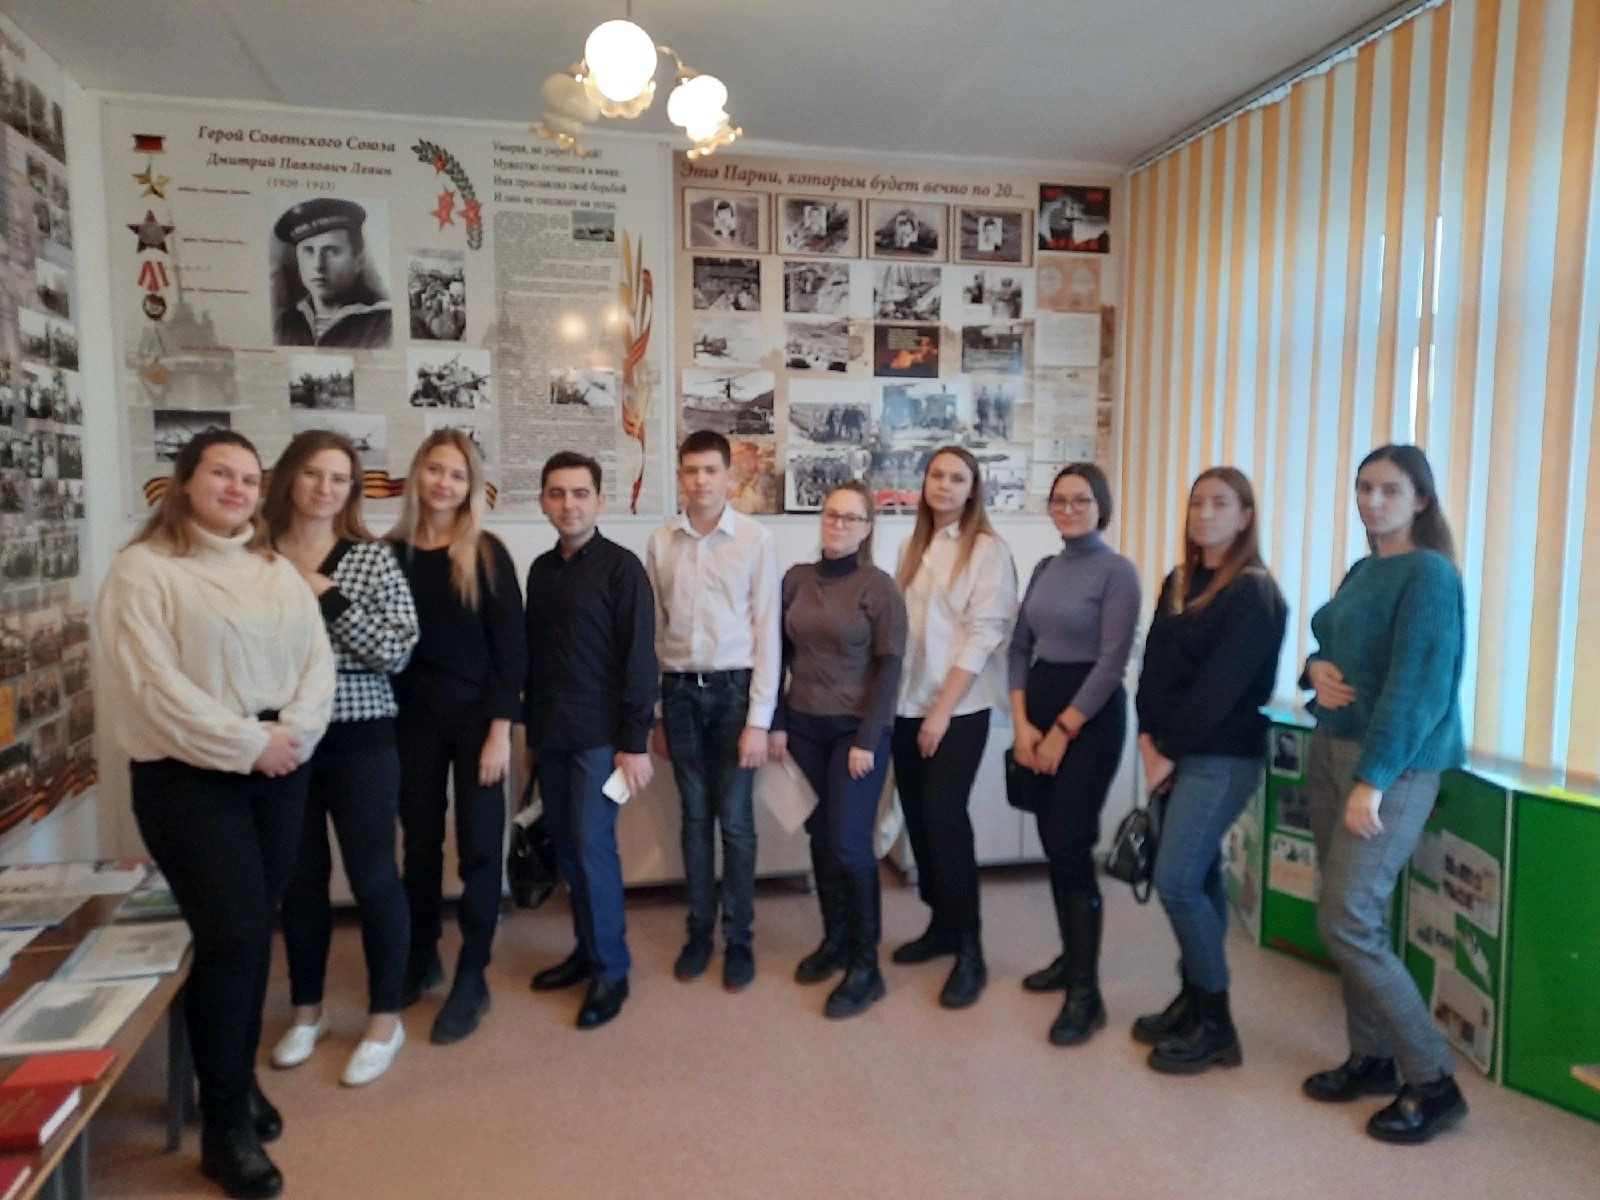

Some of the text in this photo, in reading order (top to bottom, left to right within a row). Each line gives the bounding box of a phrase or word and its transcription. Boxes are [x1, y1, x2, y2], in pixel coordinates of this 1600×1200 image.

[198, 125, 396, 152] Герой Советского Союза
[206, 151, 276, 169] Дмитрий
[280, 157, 347, 174] Павлович
[679, 162, 719, 179] Это
[723, 164, 782, 186] Парни,
[788, 173, 866, 191] которым
[870, 174, 919, 194] будет
[923, 181, 969, 195] вечно
[972, 184, 991, 196] по
